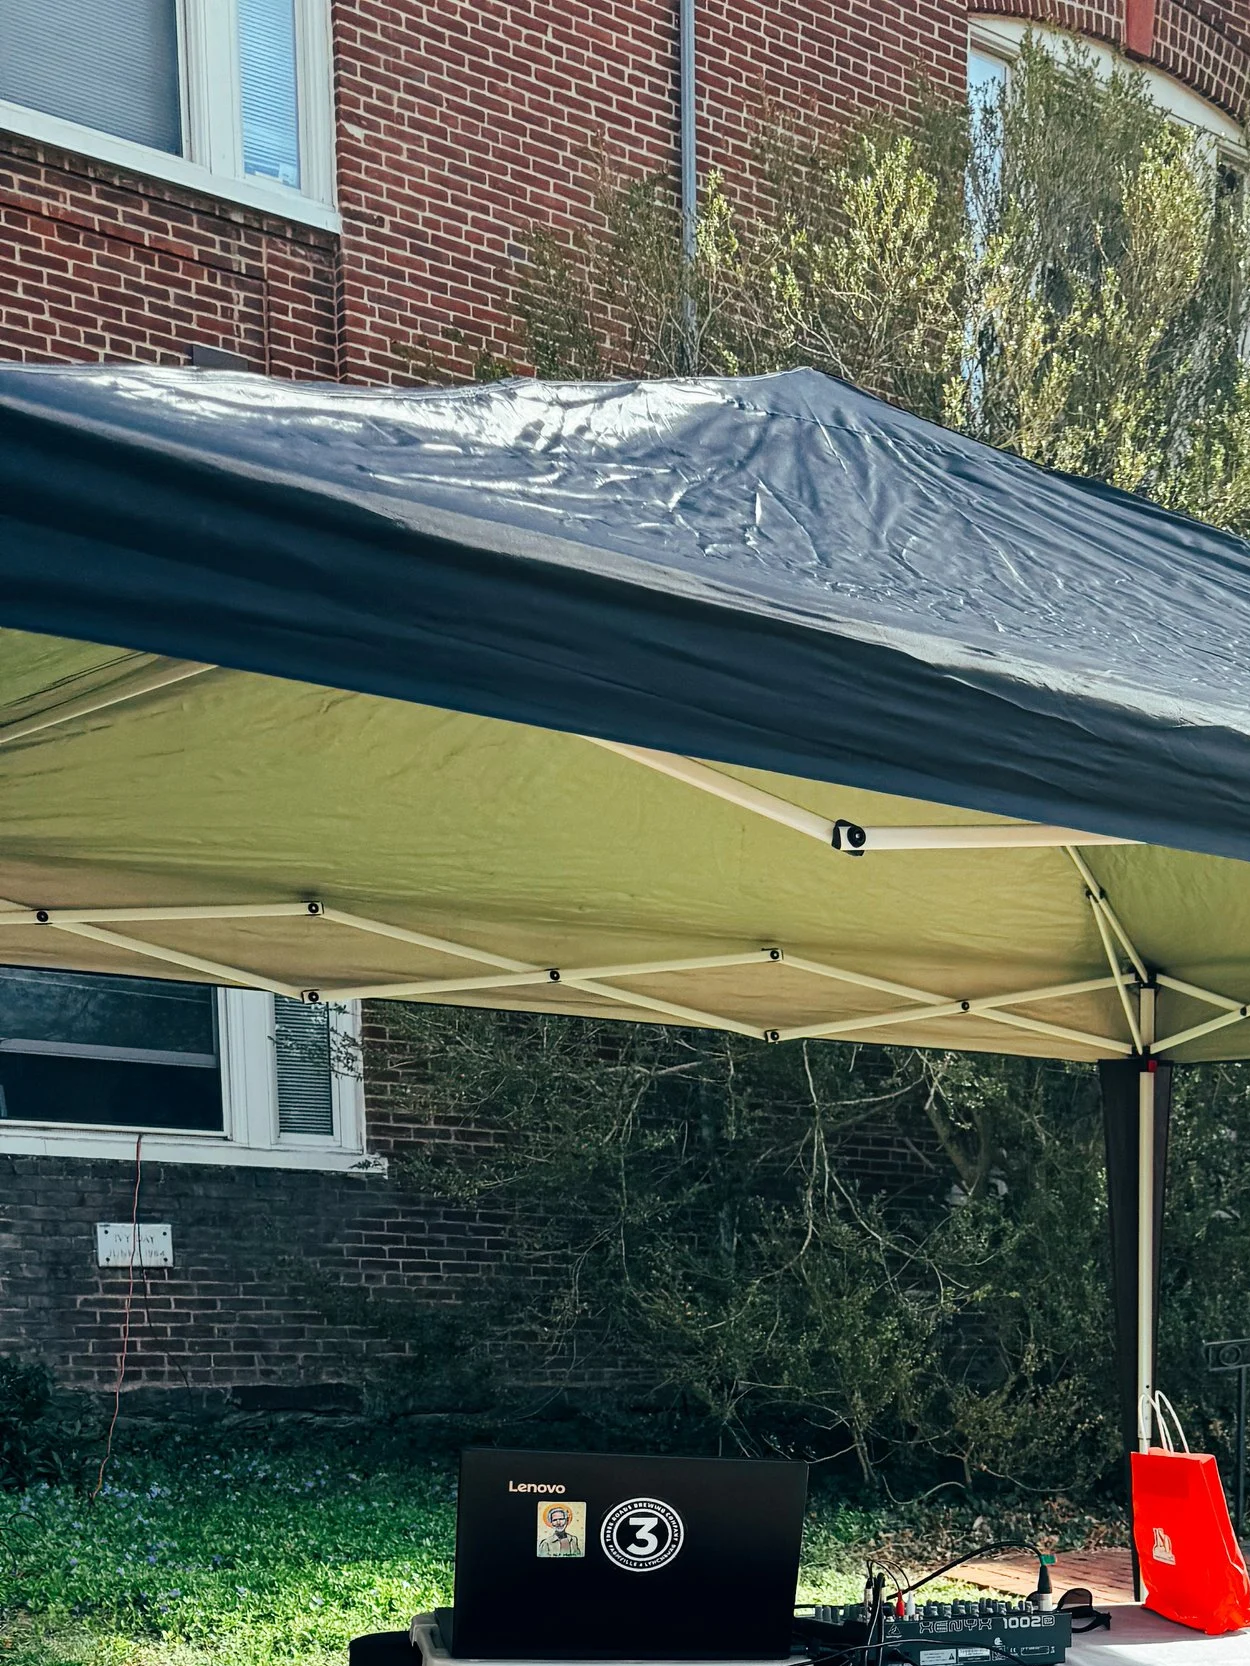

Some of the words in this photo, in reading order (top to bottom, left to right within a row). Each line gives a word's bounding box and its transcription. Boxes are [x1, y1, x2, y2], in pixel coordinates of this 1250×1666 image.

[509, 1480, 566, 1494] Lenovo
[626, 1517, 659, 1556] 3
[919, 1617, 992, 1634] XENYX
